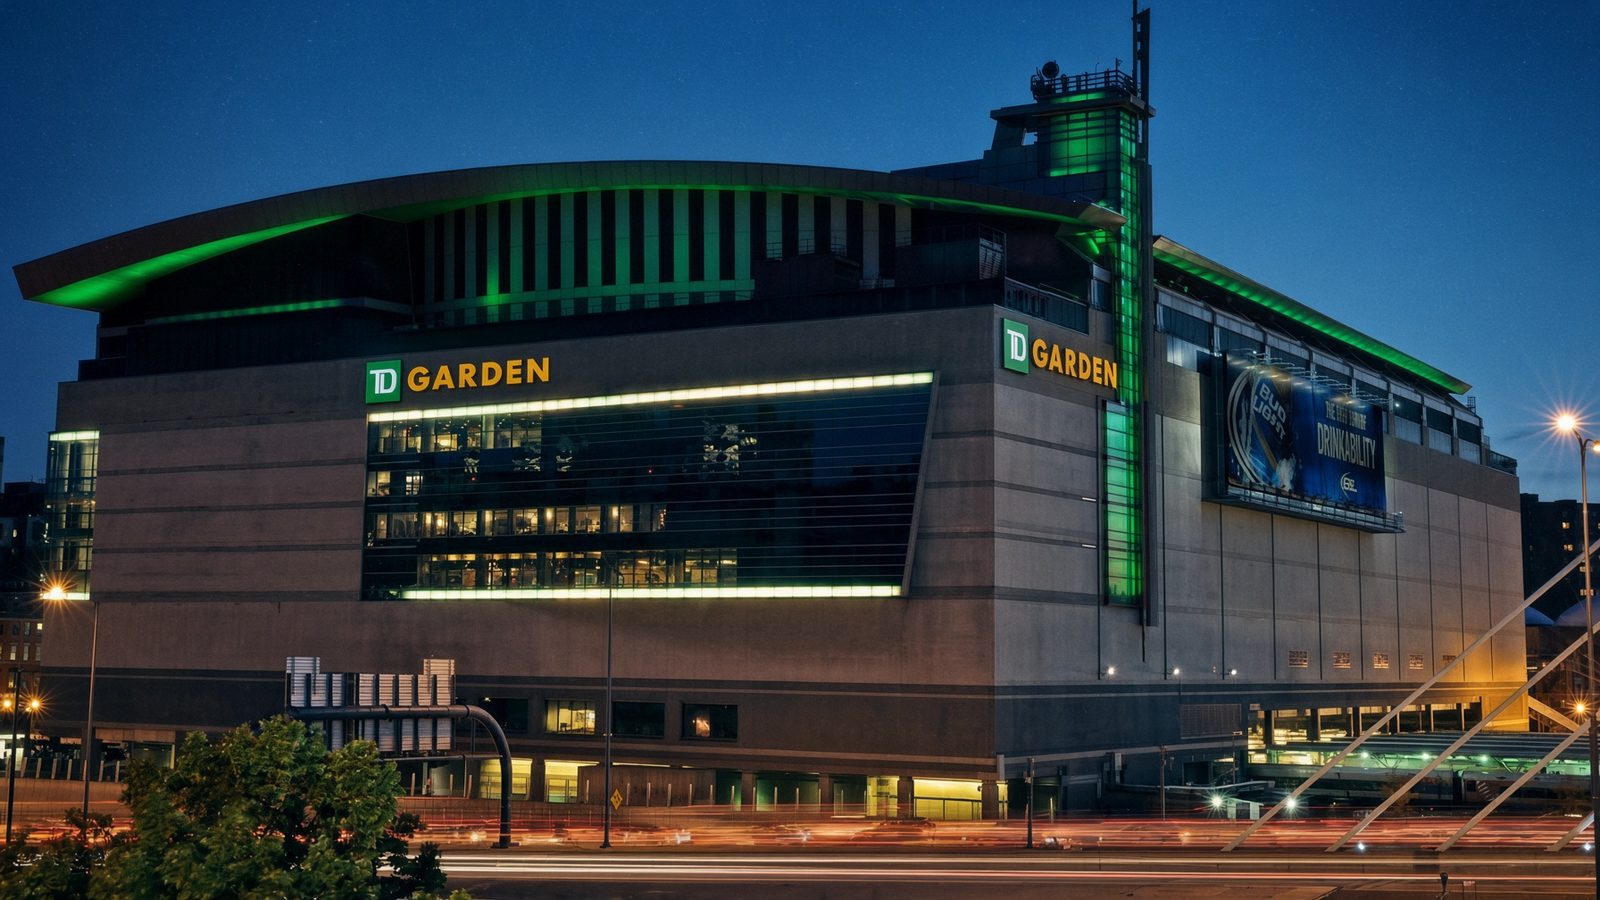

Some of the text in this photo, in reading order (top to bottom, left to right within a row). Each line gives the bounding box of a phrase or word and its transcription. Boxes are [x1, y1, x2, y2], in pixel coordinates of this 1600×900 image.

[369, 357, 550, 395] TD GARDEN
[1007, 329, 1118, 390] TD GARDEN
[1260, 382, 1286, 424] BUD
[1317, 422, 1376, 470] DRINKABILITY
